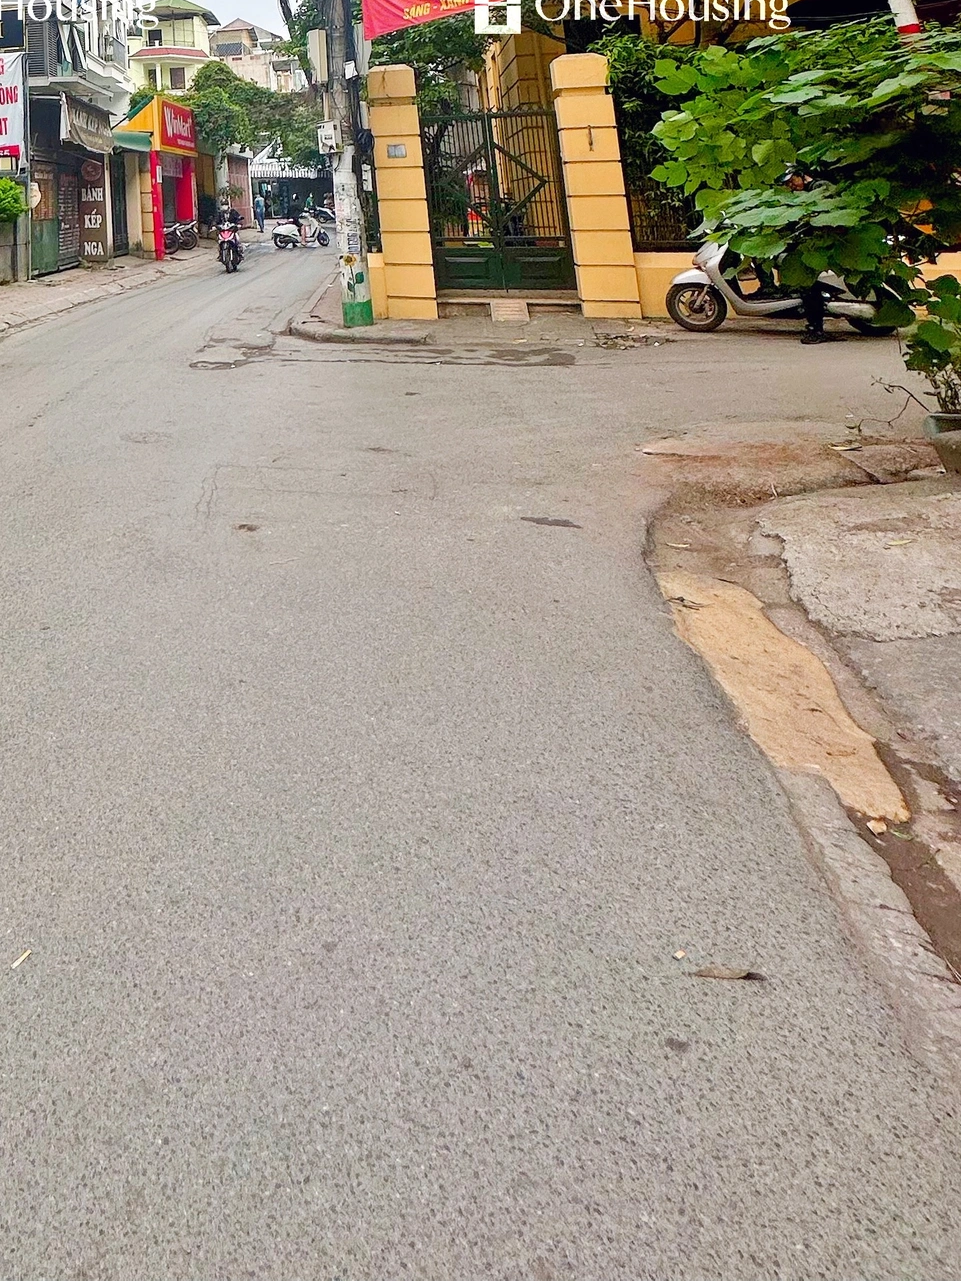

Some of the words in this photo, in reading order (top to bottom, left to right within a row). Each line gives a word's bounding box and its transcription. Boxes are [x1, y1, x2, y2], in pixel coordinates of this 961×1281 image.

[403, 1, 431, 20] SÁNG
[81, 184, 104, 202] BÁNH
[84, 208, 103, 229] KÉP
[84, 241, 105, 256] NGA
